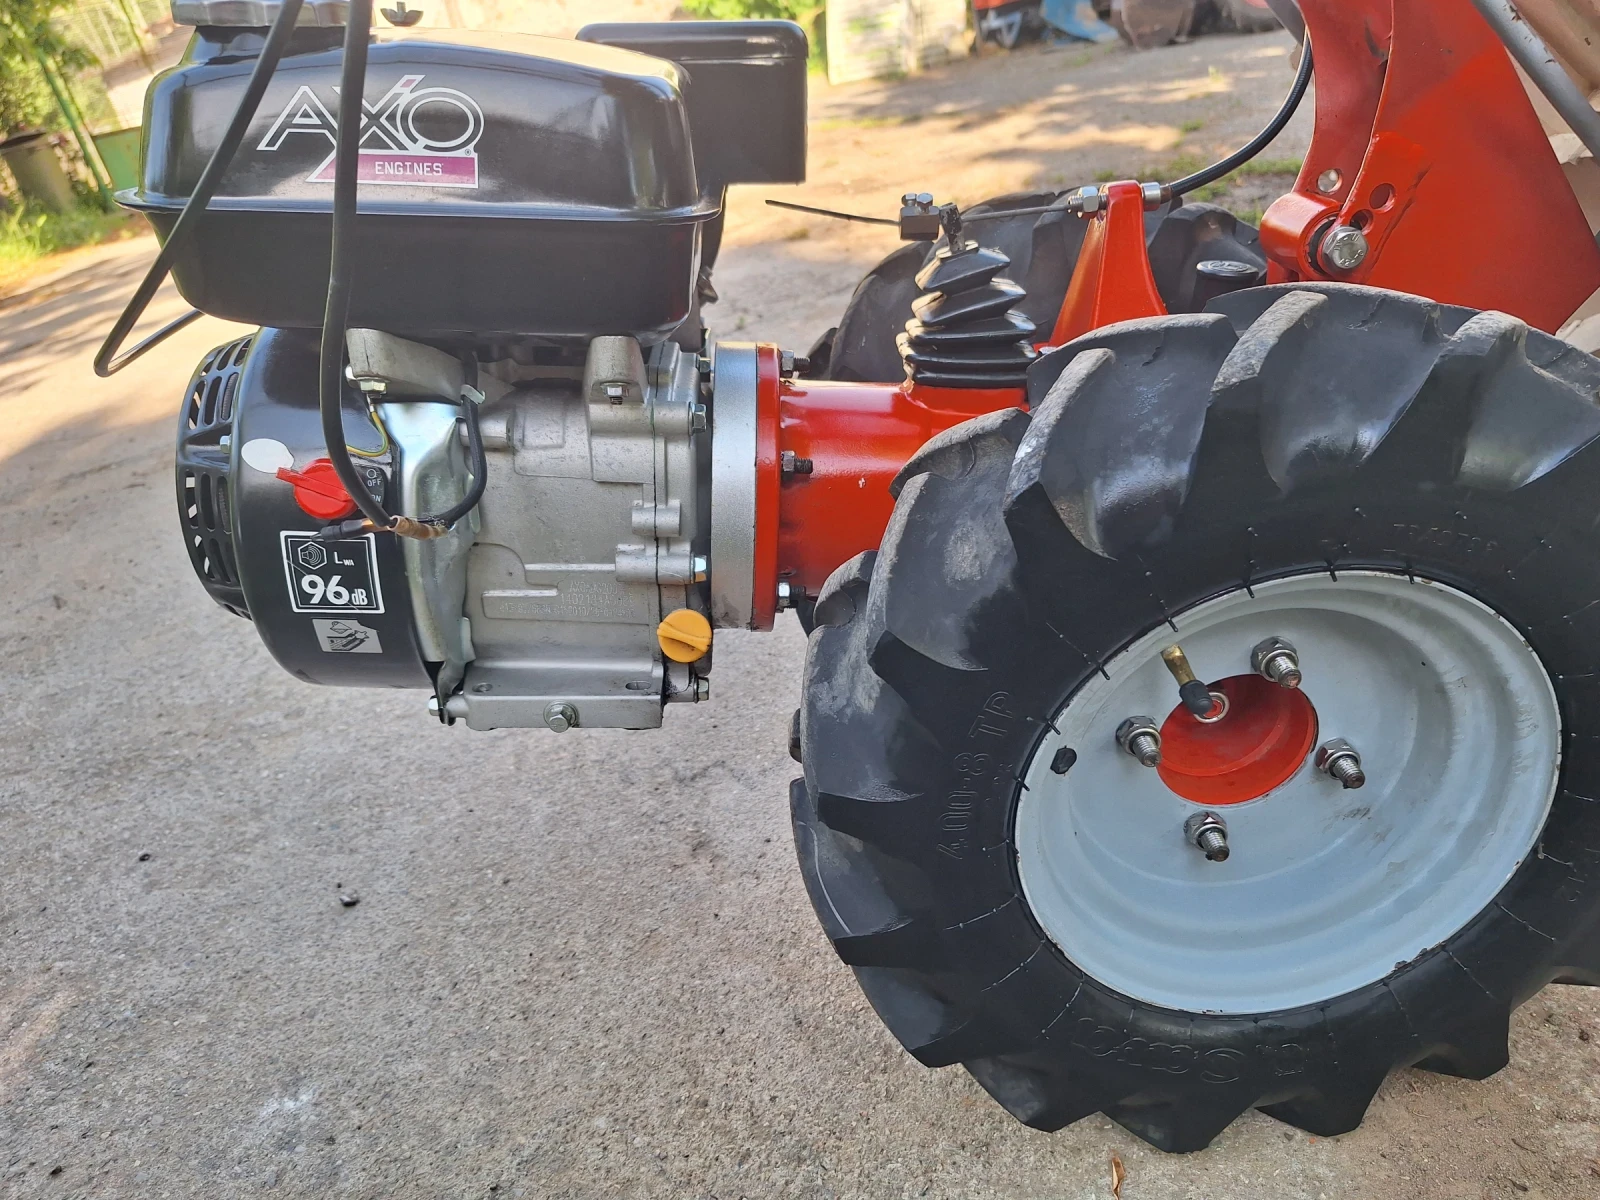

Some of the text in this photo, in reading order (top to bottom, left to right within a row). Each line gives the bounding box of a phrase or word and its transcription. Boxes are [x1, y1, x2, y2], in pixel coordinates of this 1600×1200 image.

[256, 75, 485, 153] AXO
[375, 161, 443, 176] ENGINES
[367, 478, 381, 487] OFF
[301, 575, 368, 605] 96 dB
